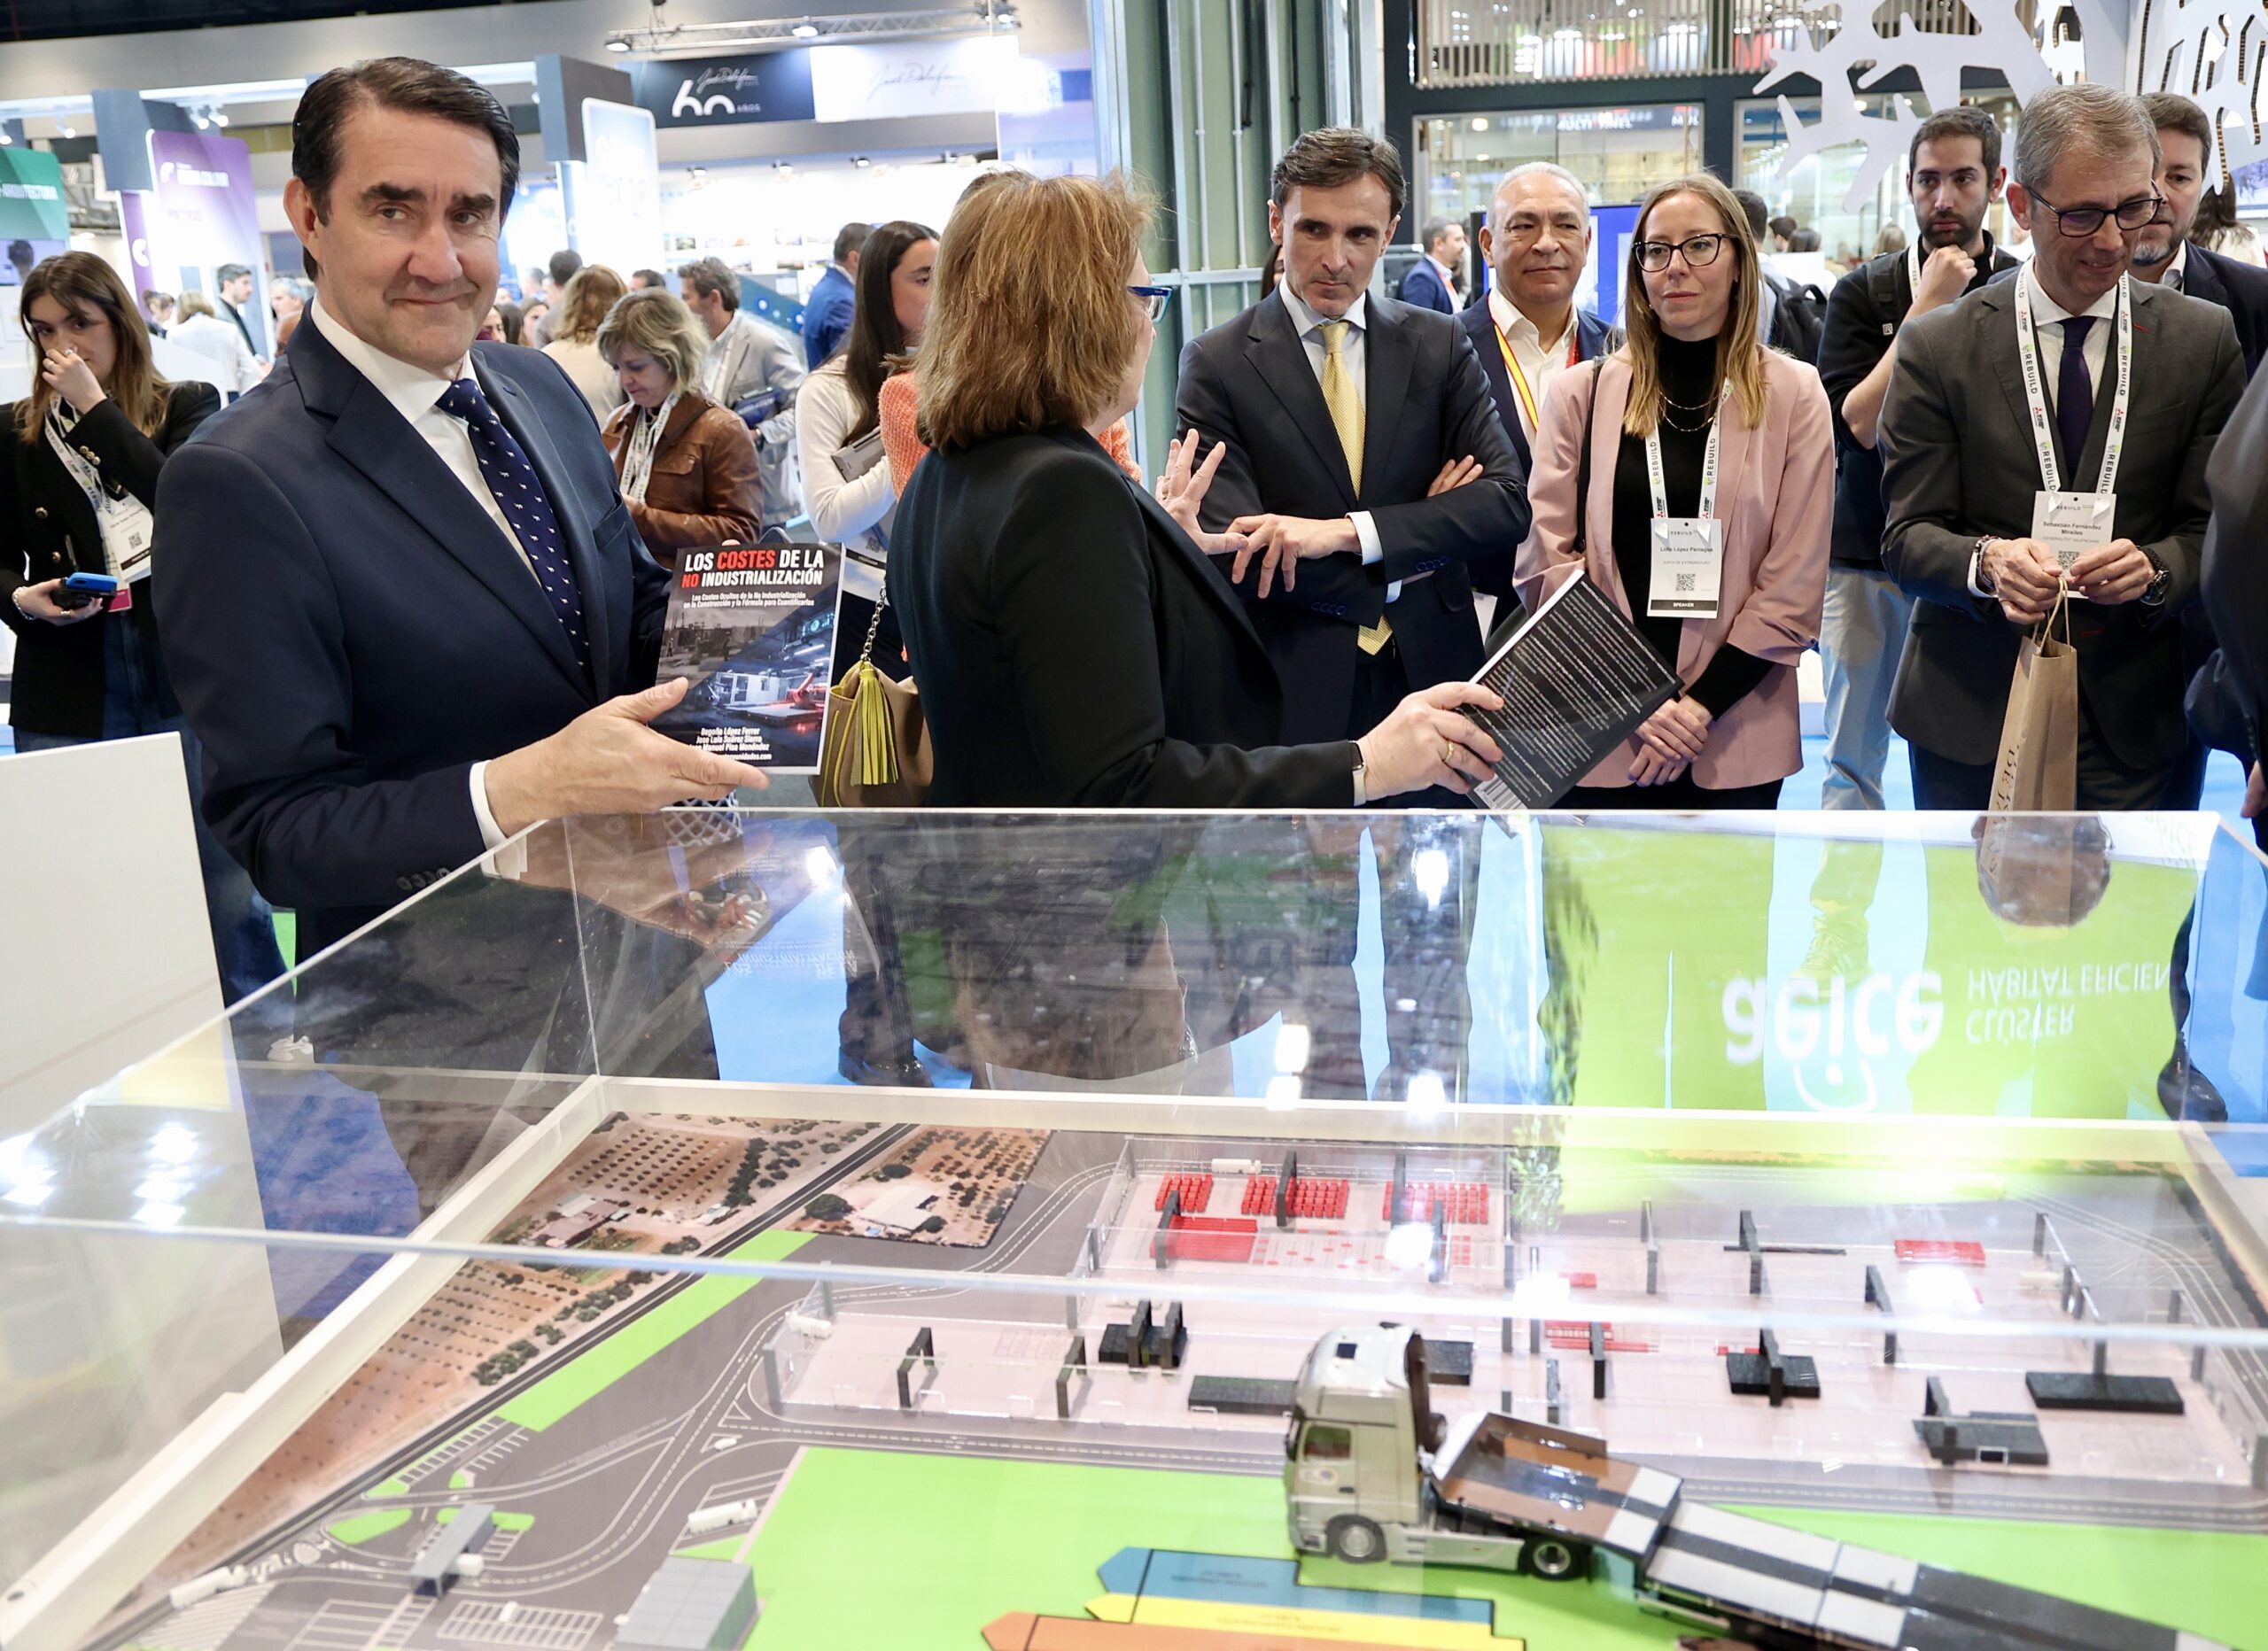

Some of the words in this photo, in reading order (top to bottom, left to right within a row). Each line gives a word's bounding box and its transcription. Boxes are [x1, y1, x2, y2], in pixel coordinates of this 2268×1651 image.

[2024, 353, 2038, 394] REBUILD
[2119, 355, 2128, 396] REBUILD
[1650, 441, 1659, 477] REBUILD
[1706, 438, 1716, 477] REBUILD
[2042, 450, 2056, 492] REBUILD
[2101, 454, 2116, 494] REBUILD
[680, 572, 701, 588] NO
[701, 568, 823, 587] INDUSTRIALIZACIÓN
[684, 553, 715, 572] LOS
[717, 549, 777, 570] COSTES
[779, 549, 800, 569] DE
[804, 549, 824, 569] LA
[740, 591, 747, 600] de
